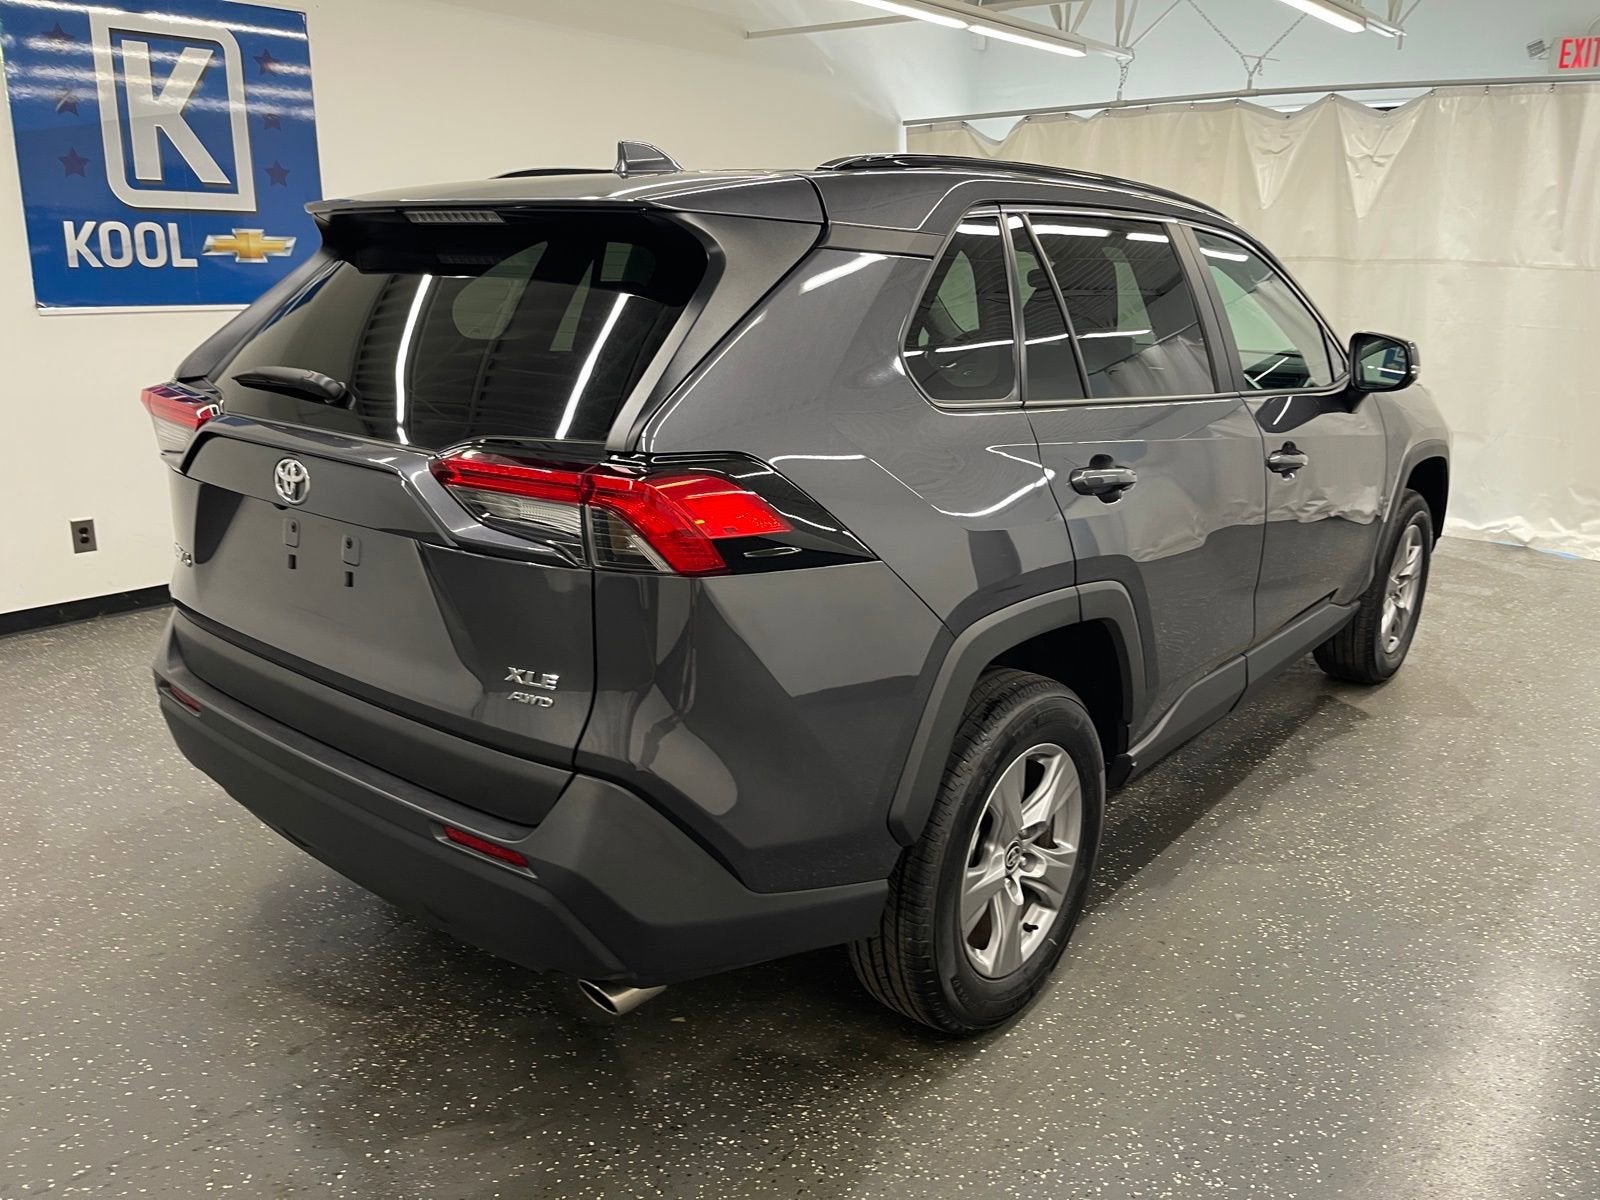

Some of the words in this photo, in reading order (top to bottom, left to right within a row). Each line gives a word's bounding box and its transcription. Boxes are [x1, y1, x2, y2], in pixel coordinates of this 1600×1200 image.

[121, 40, 231, 184] K
[63, 221, 198, 268] KOOL
[504, 666, 560, 690] XLE
[506, 691, 554, 707] AWD
